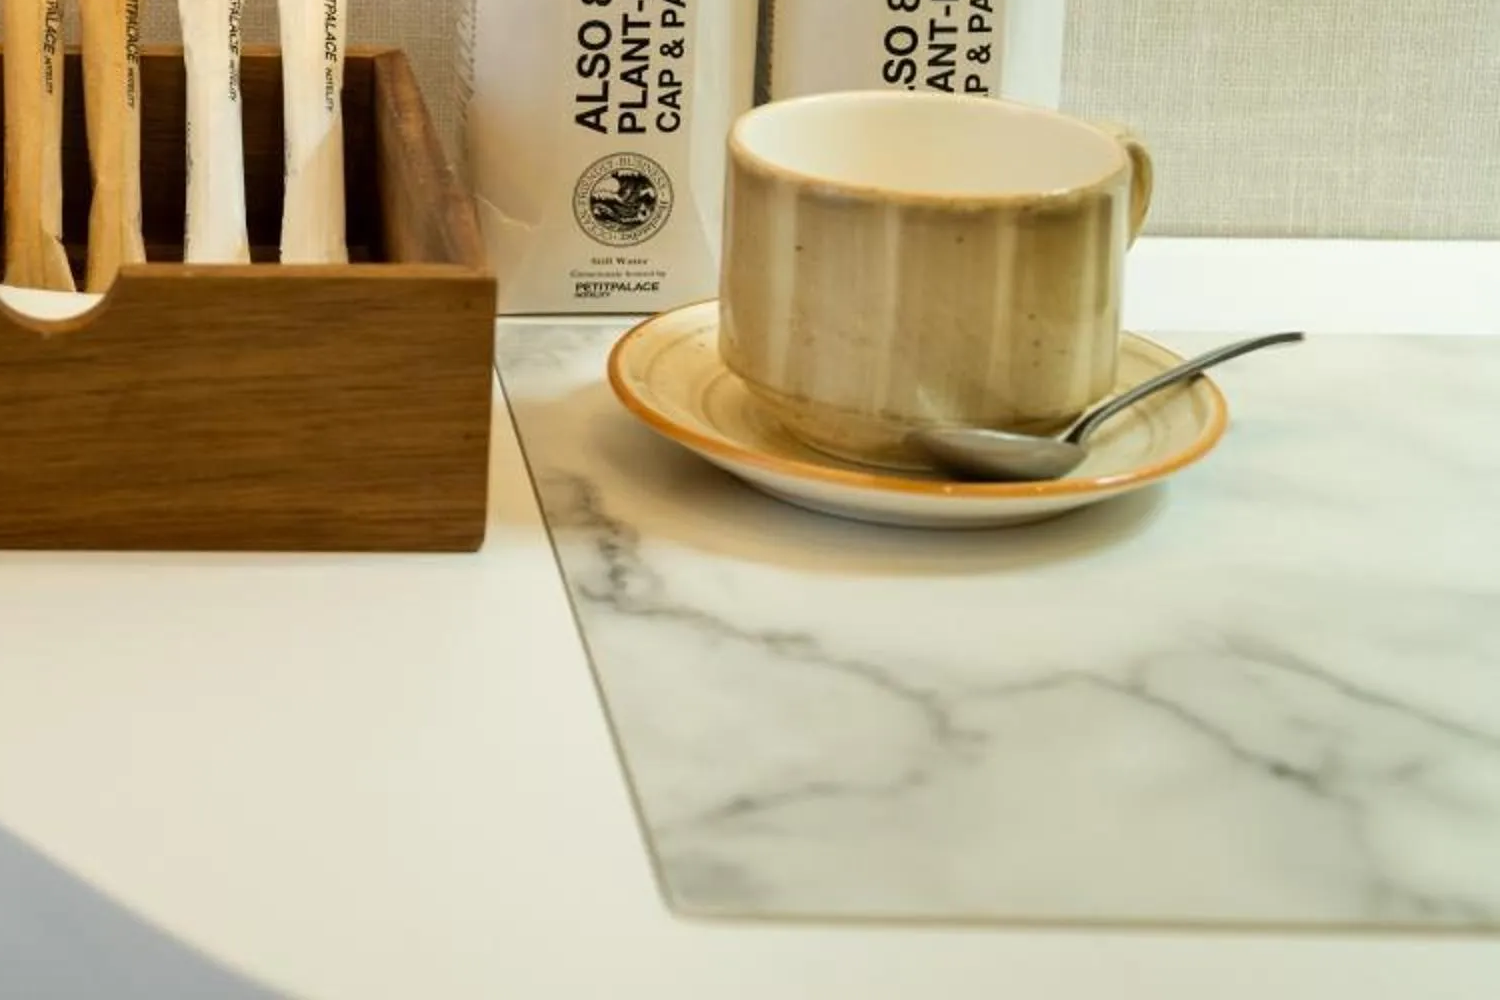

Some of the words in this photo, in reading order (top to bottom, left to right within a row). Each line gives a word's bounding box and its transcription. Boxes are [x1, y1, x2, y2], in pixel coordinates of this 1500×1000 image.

[659, 38, 685, 60] &
[882, 25, 919, 91] SO
[966, 44, 991, 64] &
[574, 19, 612, 134] ALSO
[655, 68, 683, 134] CAP
[575, 281, 660, 292] PETITPALACE
